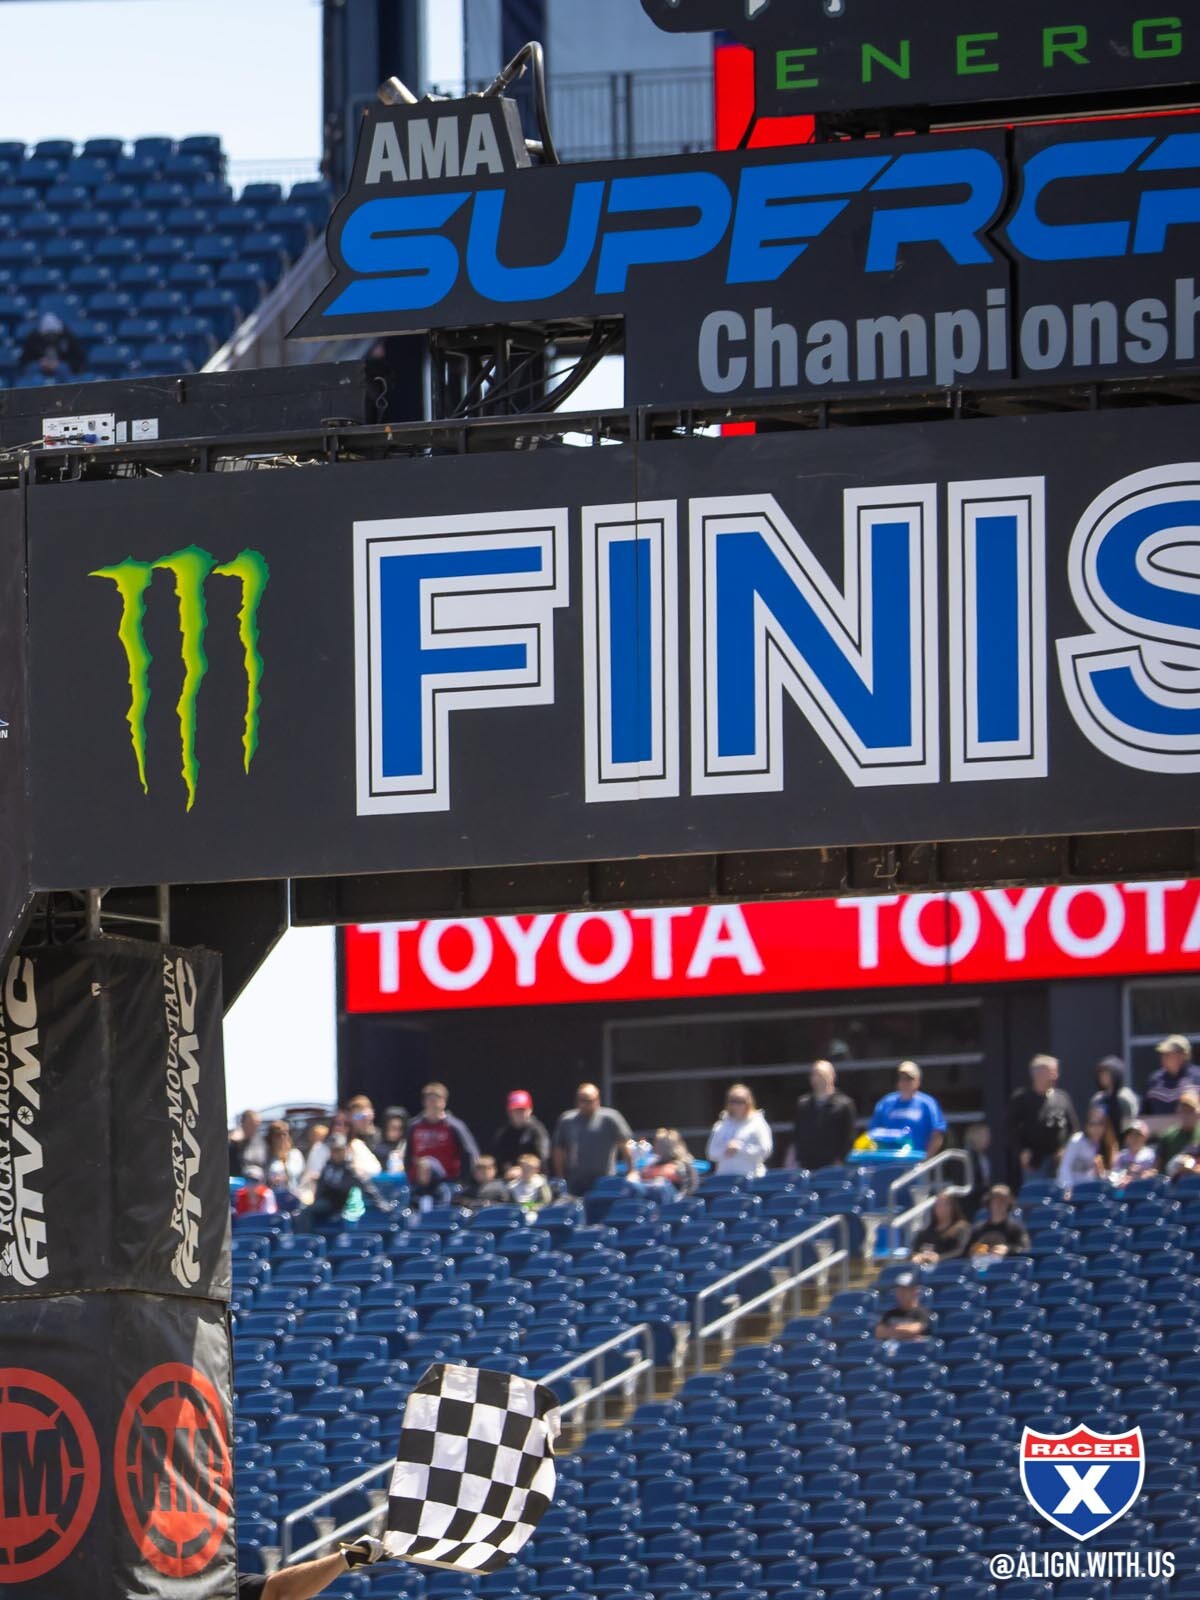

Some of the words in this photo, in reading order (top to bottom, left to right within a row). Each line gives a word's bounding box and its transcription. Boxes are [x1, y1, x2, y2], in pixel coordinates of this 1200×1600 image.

[775, 16, 1183, 90] ENERG
[365, 112, 505, 184] AMA
[353, 461, 1200, 816] FINIS
[357, 904, 765, 994] TOYOTA
[163, 953, 184, 1129] MOUNTAIN
[169, 1129, 186, 1236] ROCKY
